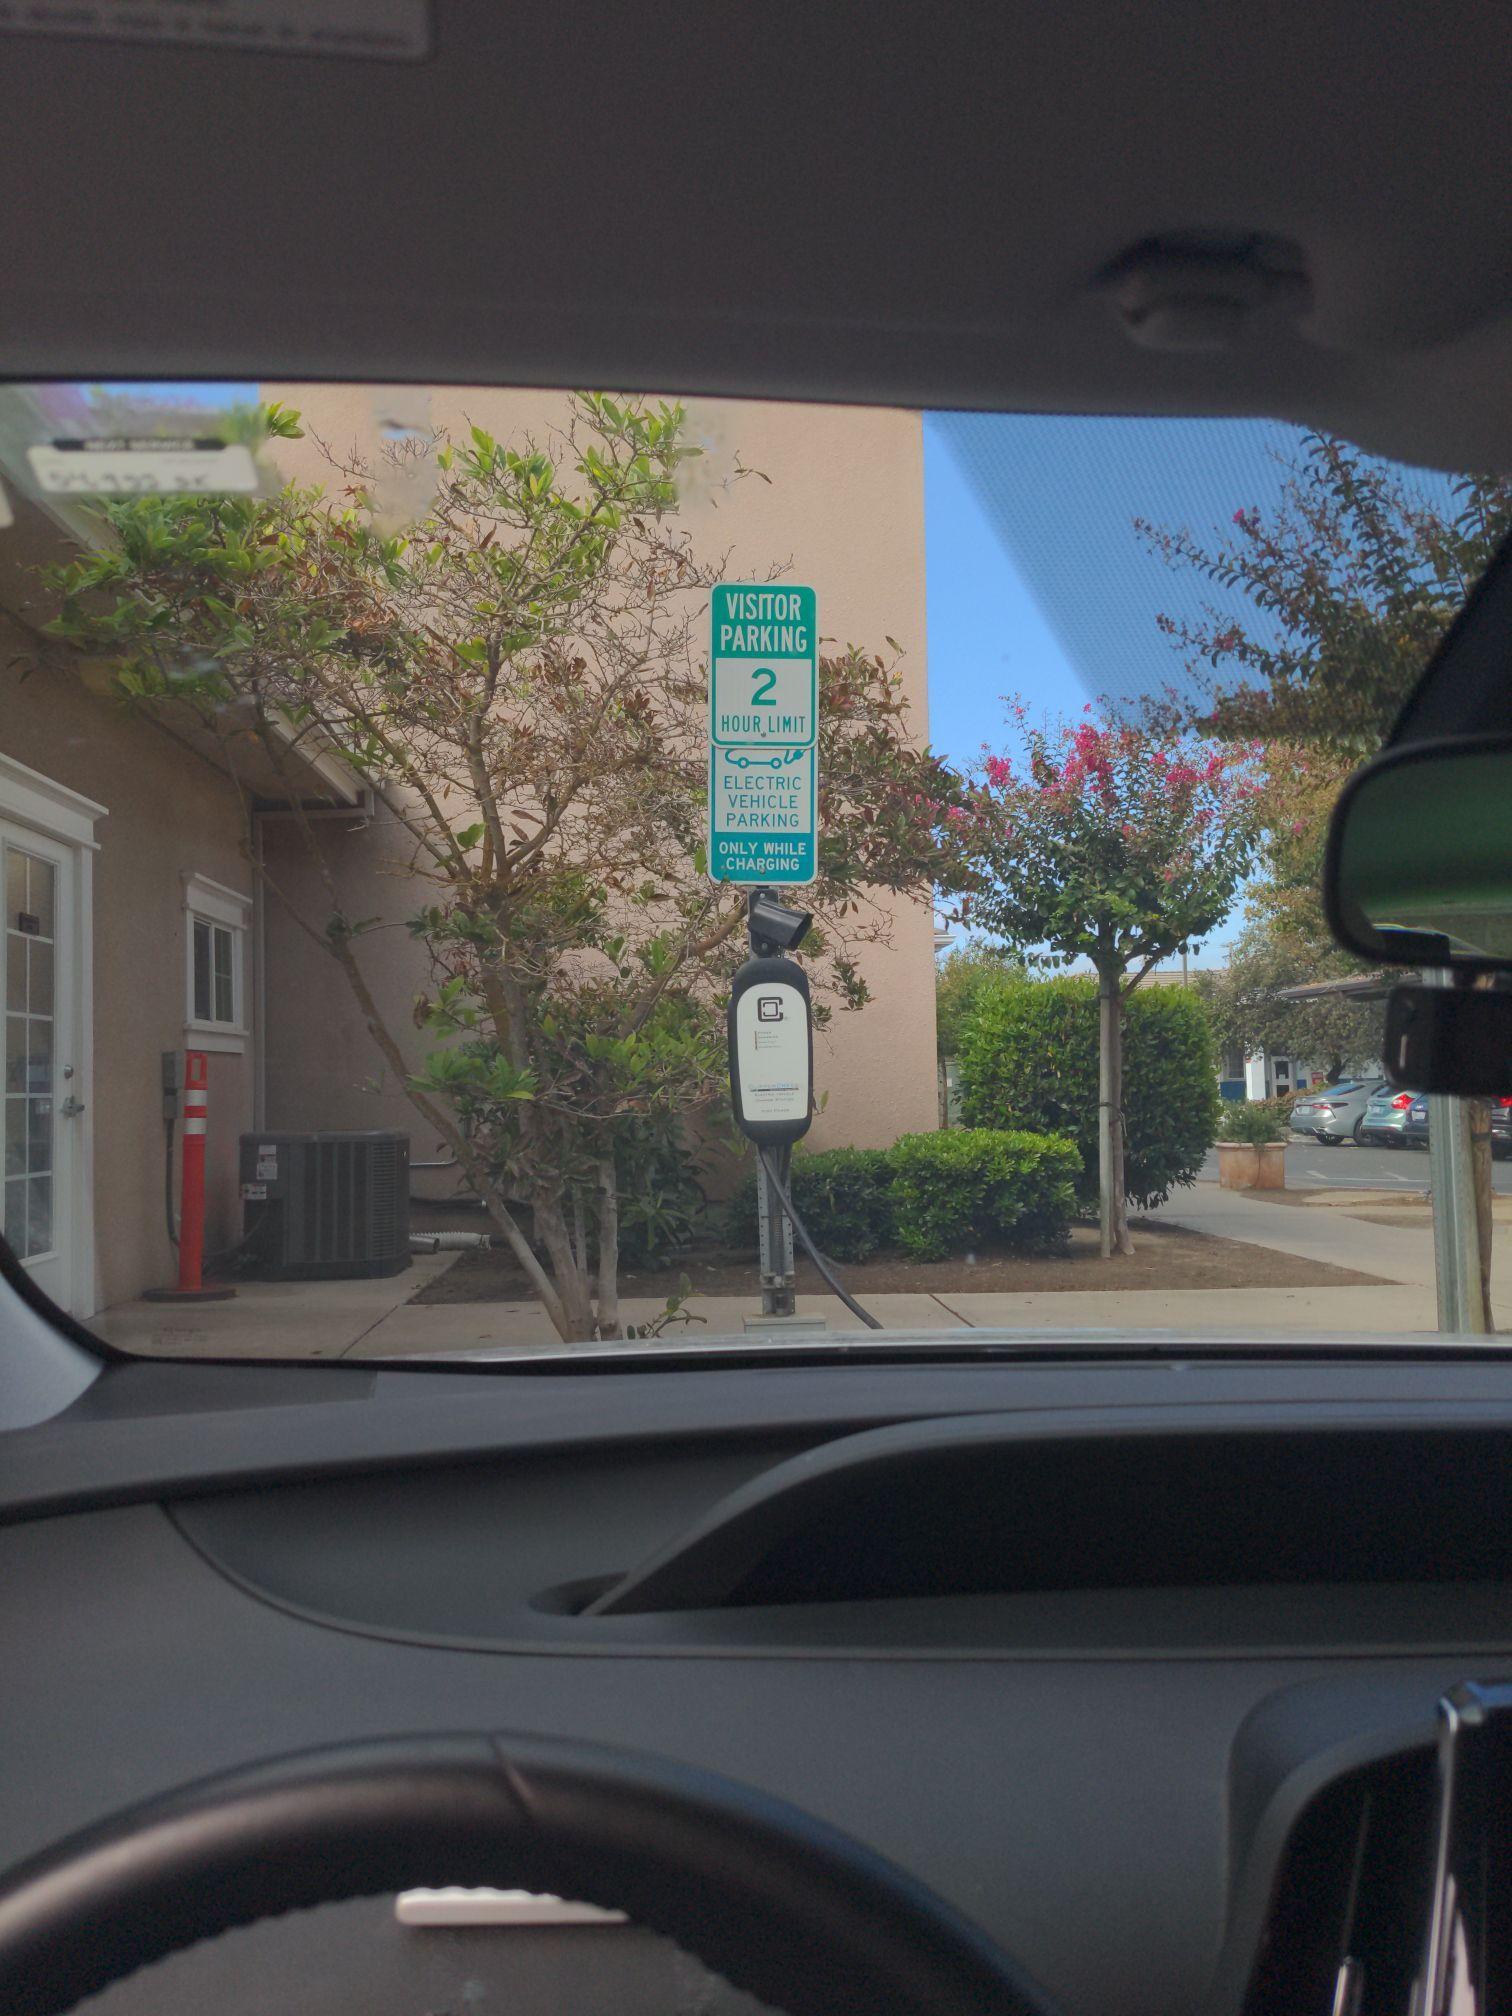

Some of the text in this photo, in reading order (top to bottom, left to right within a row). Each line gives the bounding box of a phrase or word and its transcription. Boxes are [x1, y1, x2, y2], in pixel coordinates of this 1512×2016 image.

[726, 593, 801, 620] VISITOR
[720, 625, 807, 652] PARKING
[751, 667, 777, 706] 2
[721, 715, 806, 733] HOUR LIMIT
[724, 775, 802, 790] ELECTRIC
[728, 795, 798, 809] VEHICLE
[726, 813, 799, 828] PARKING
[719, 842, 807, 855] ONLY WHILE
[726, 858, 800, 870] CHARGING
